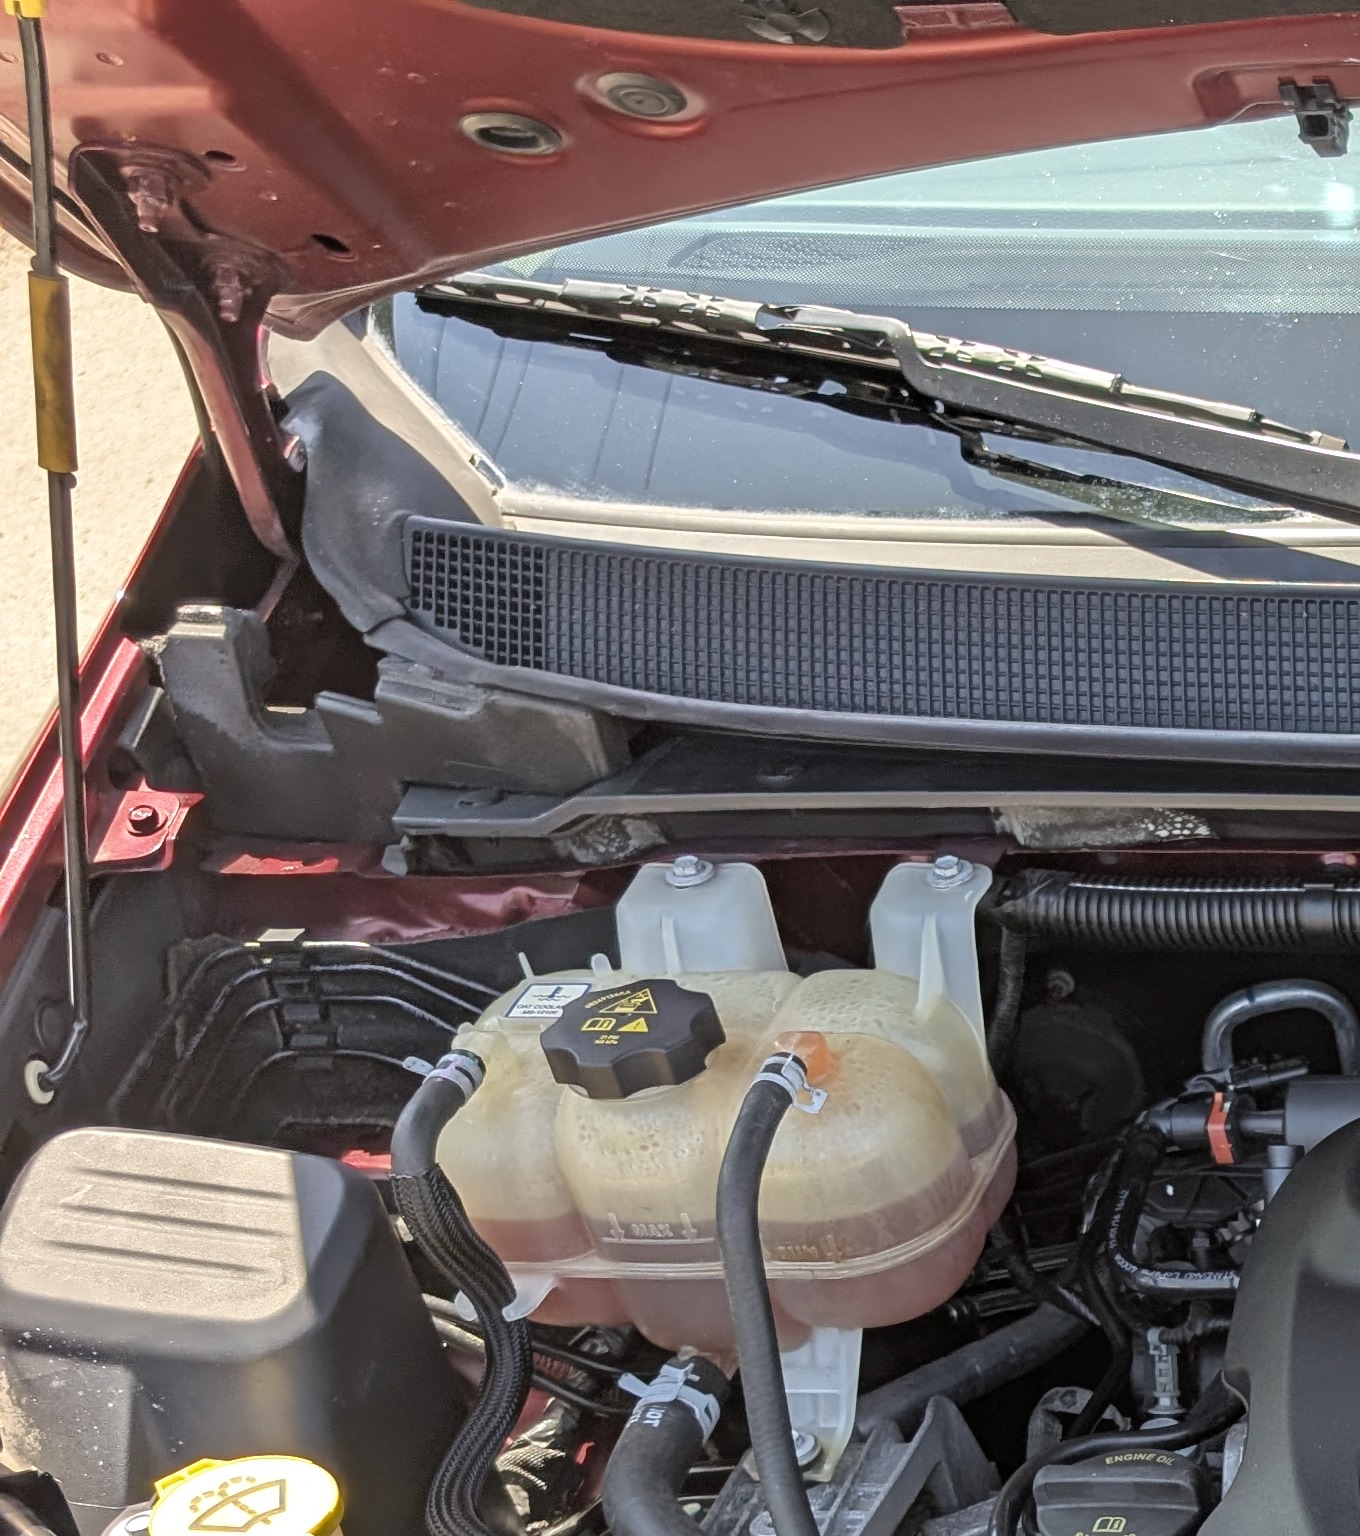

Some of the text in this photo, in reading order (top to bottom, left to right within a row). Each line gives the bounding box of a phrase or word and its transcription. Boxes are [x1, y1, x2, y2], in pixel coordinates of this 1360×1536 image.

[631, 1223, 674, 1238] MAX
[1105, 1453, 1177, 1466] ENGINE OIL
